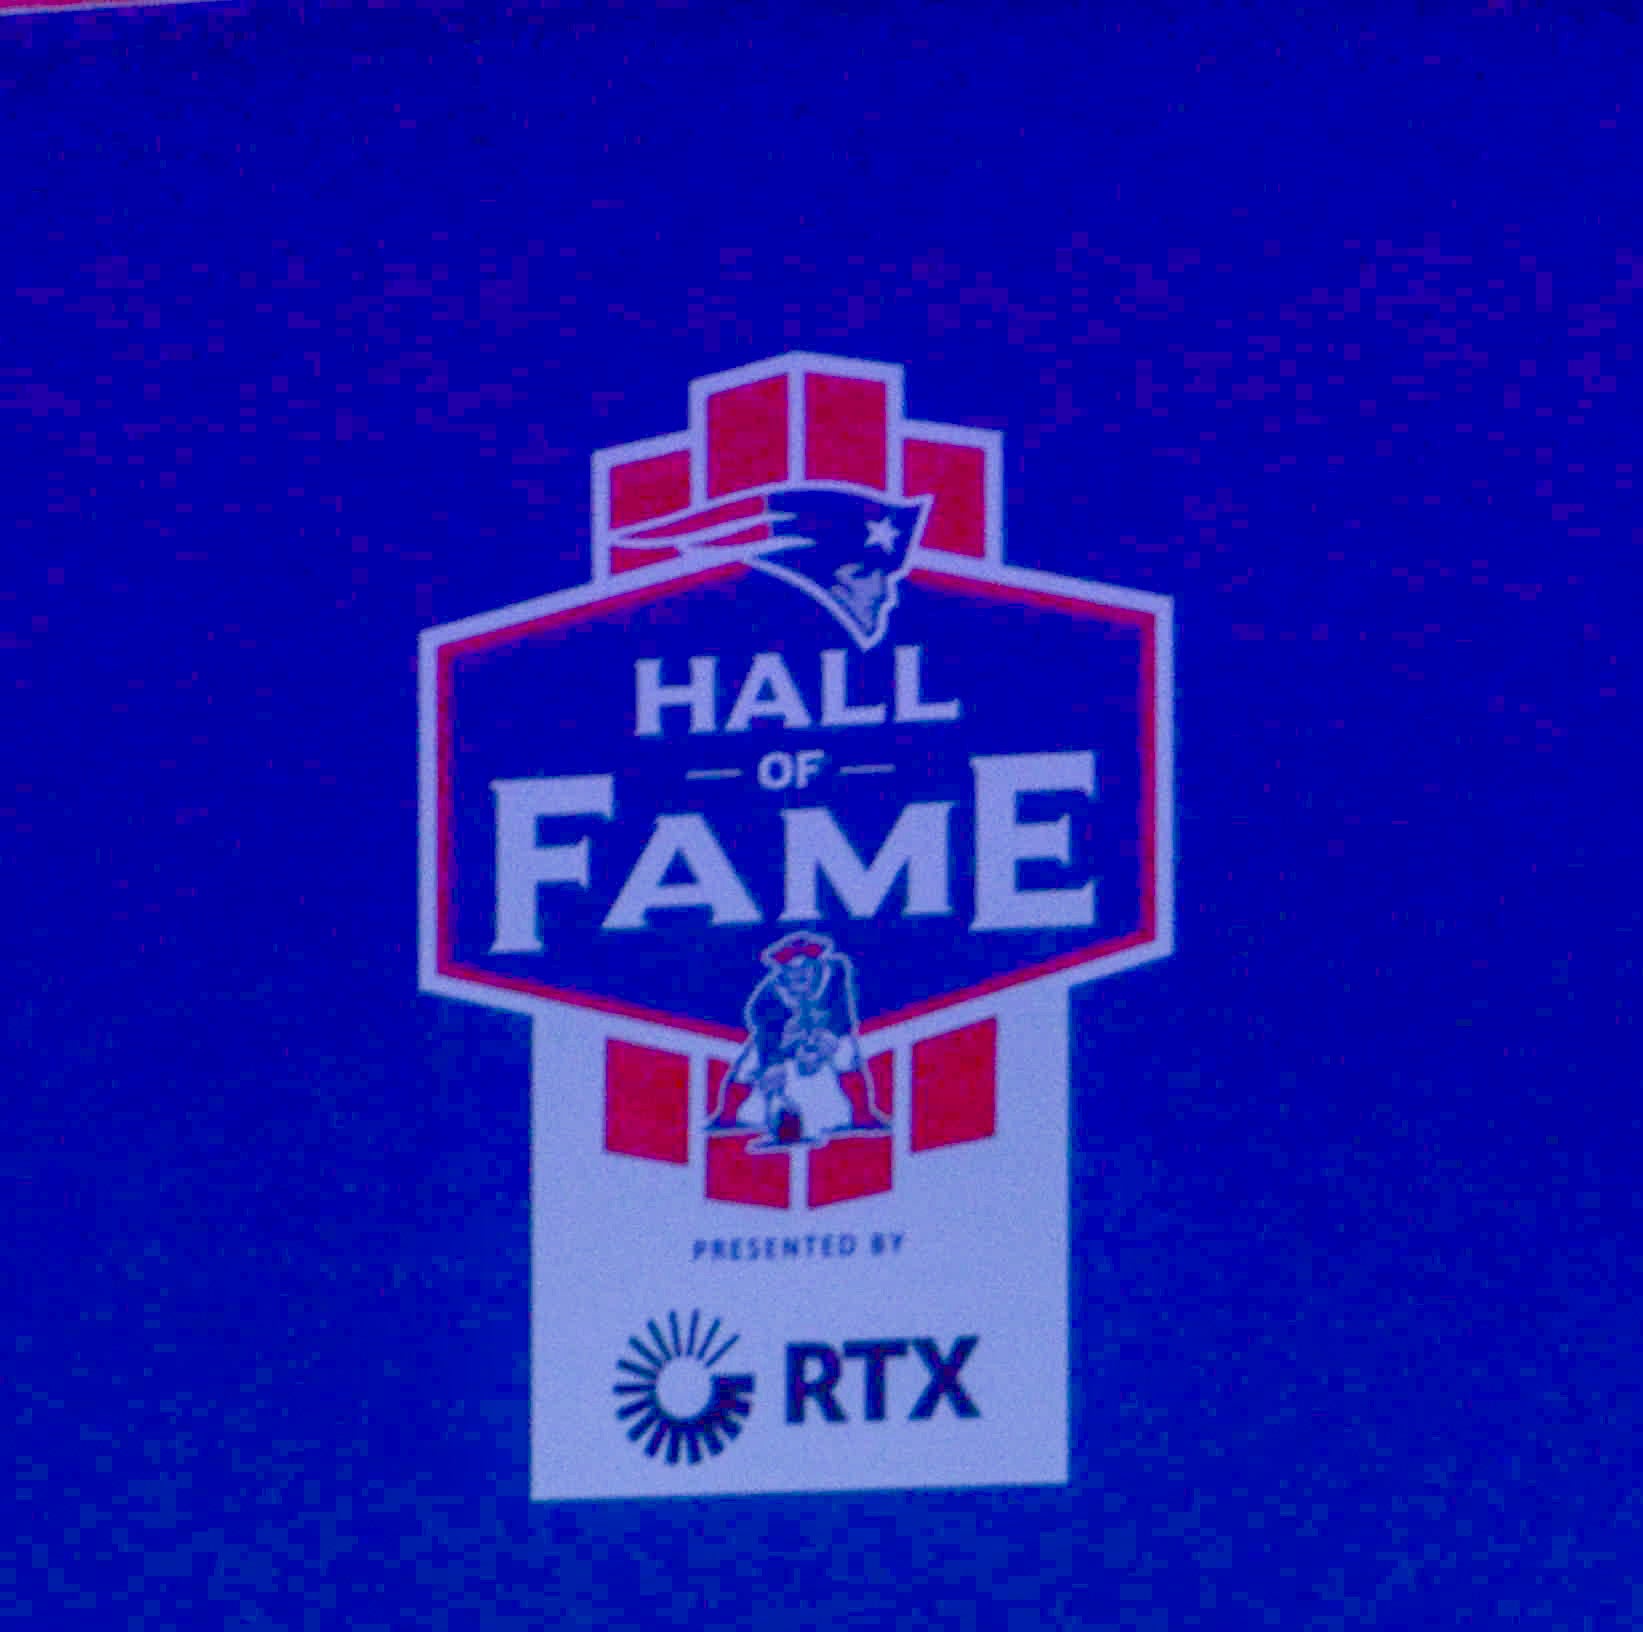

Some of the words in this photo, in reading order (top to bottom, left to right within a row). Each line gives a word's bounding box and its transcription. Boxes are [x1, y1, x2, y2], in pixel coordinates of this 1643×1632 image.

[634, 645, 962, 737] HALL
[756, 748, 826, 791] OF
[488, 749, 1097, 955] FAME
[691, 1233, 858, 1262] PRESENTED
[869, 1231, 905, 1257] BY
[785, 1335, 981, 1425] RTX
